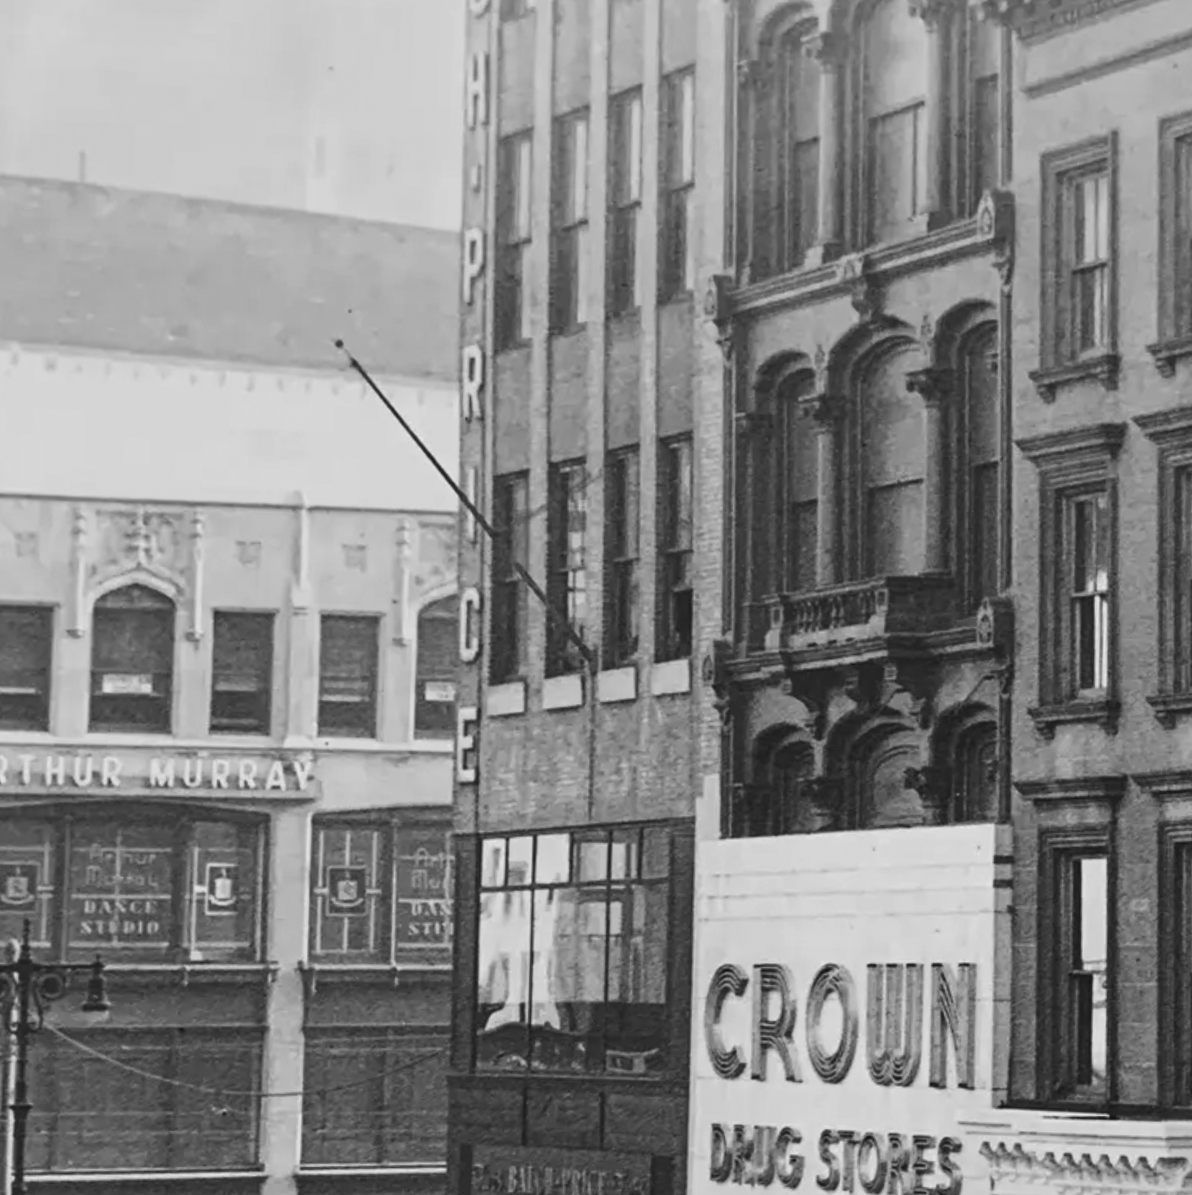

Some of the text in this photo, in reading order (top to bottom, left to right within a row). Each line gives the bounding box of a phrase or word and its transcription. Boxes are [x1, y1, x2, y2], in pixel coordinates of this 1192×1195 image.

[457, 0, 490, 784] H-PRICE
[150, 757, 315, 791] MURRAY
[80, 920, 160, 935] STUDIO
[83, 900, 157, 915] DANCE
[703, 962, 977, 1091] CROWN
[708, 1123, 806, 1191] DRUG
